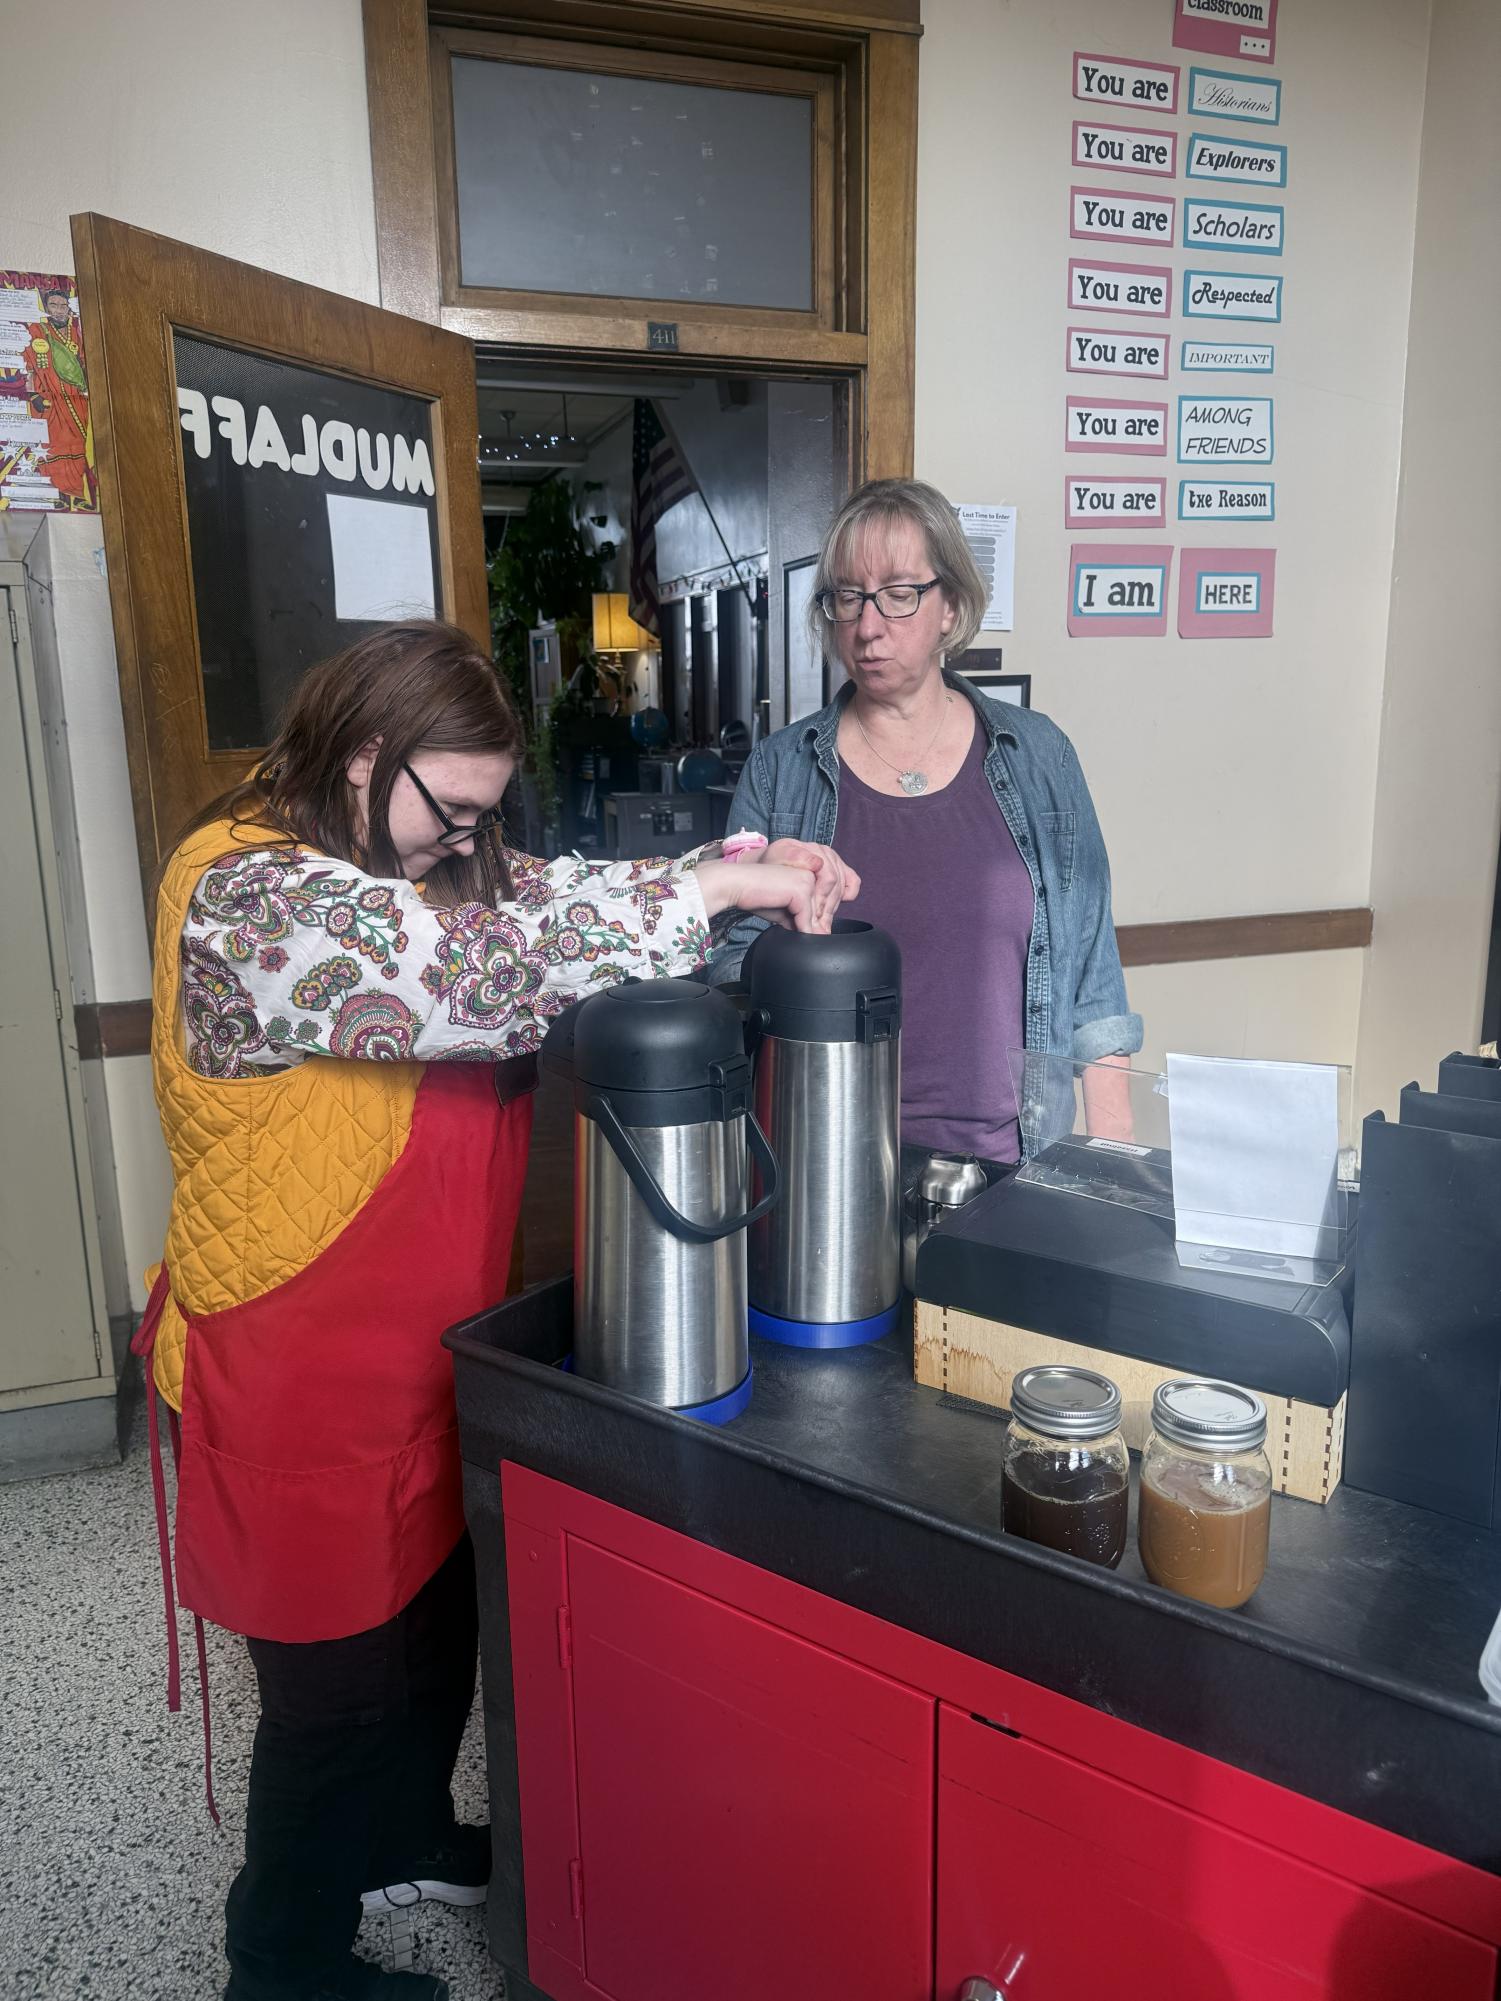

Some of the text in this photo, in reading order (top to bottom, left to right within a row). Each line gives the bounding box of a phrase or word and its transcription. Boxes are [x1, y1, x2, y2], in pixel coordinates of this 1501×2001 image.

[1082, 66, 1168, 102] You are
[1198, 82, 1273, 113] Historians
[1082, 133, 1167, 165] You are
[1196, 147, 1276, 173] Explorers
[1083, 201, 1168, 232] You are
[1193, 212, 1275, 240] Scholars
[1078, 274, 1163, 304] You are
[1192, 281, 1274, 309] Respected
[1076, 337, 1159, 365] You are
[1189, 352, 1270, 364] IMPORTANT
[1077, 412, 1159, 436] You are
[1186, 406, 1252, 427] AMONG
[1186, 437, 1267, 455] FRIENDS
[1074, 487, 1156, 511] You are
[1218, 490, 1267, 507] Reason
[1083, 574, 1155, 607] I am
[1204, 584, 1252, 605] HERE
